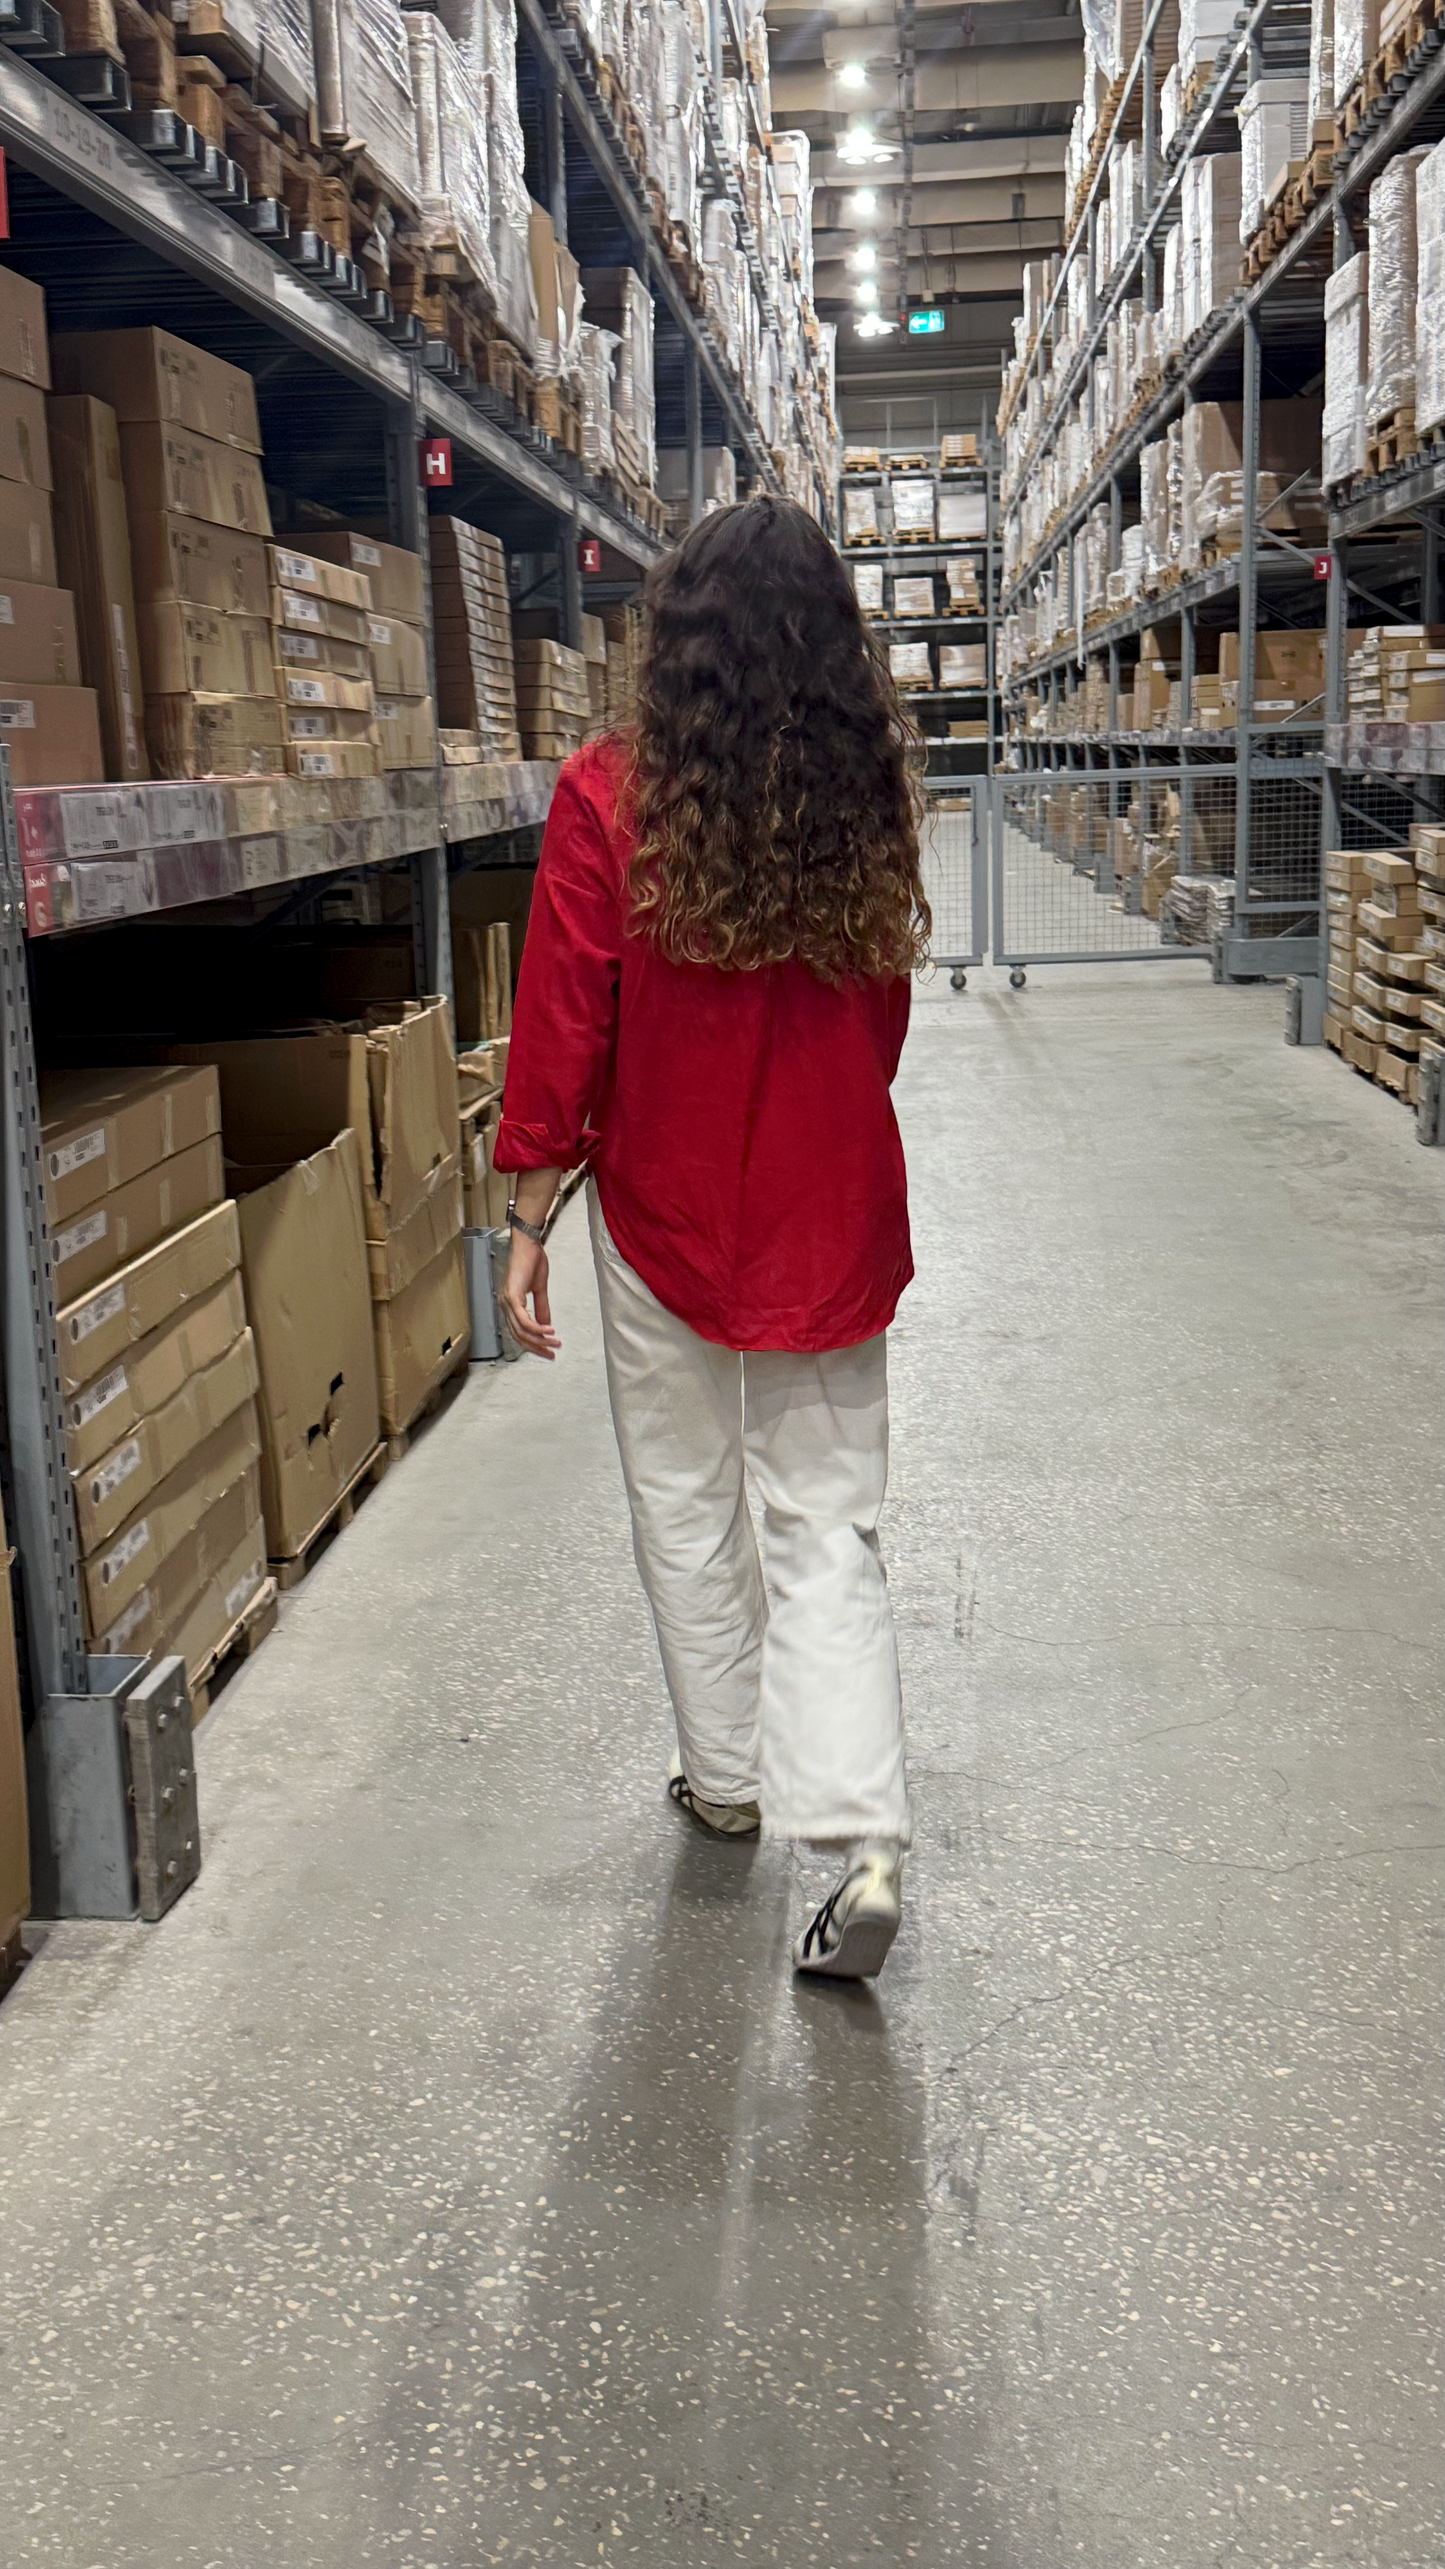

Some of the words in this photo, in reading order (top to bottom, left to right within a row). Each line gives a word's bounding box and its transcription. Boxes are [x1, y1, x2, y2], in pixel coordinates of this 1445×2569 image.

[426, 452, 446, 475] H
[584, 549, 594, 565] I
[1318, 561, 1327, 574] J
